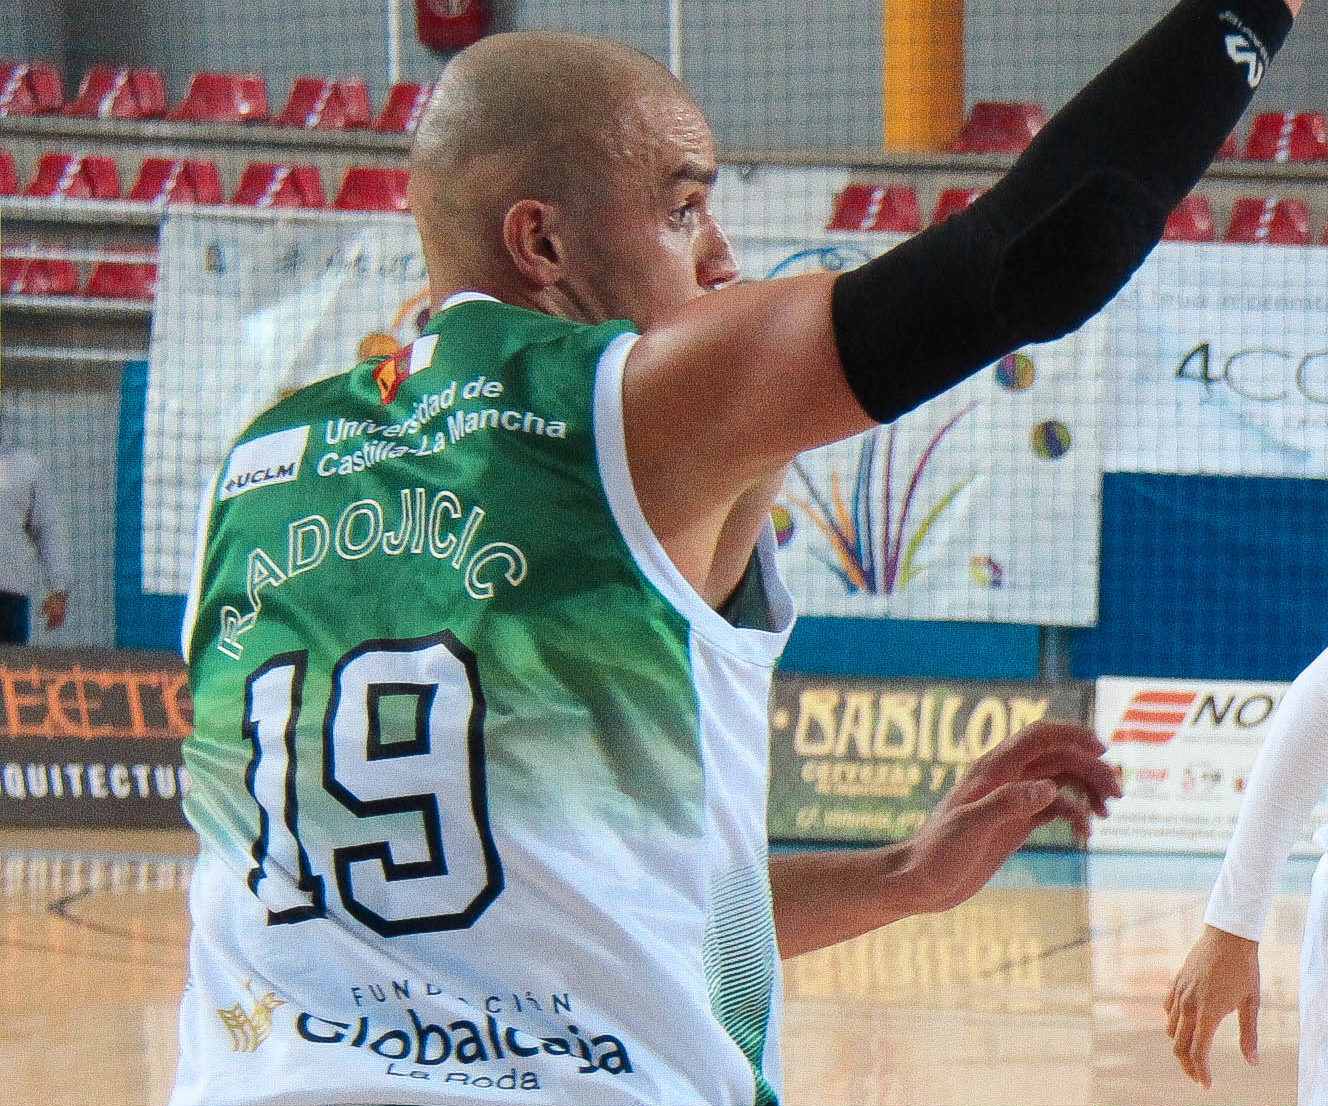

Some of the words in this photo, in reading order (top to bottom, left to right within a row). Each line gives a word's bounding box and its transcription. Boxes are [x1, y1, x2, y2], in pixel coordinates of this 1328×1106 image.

[326, 380, 457, 446] Universidad
[462, 376, 504, 400] de
[447, 408, 567, 444] Mancha
[243, 629, 505, 938] 19
[297, 1009, 635, 1074] Globalcaja
[386, 1063, 431, 1081] La
[444, 1067, 543, 1091] Roda
